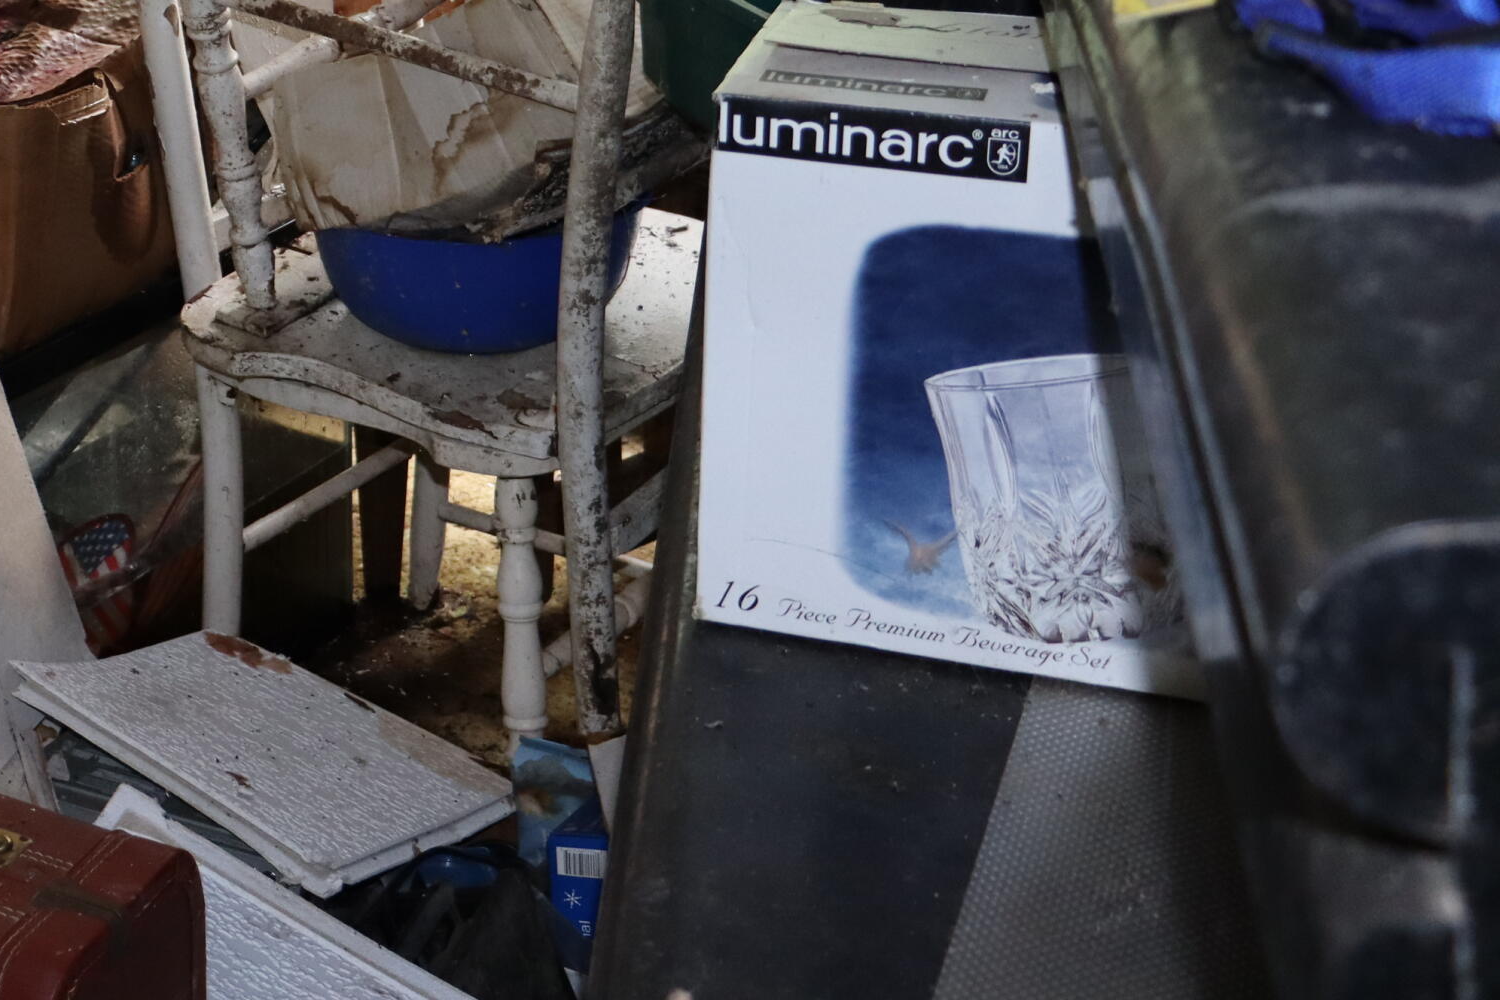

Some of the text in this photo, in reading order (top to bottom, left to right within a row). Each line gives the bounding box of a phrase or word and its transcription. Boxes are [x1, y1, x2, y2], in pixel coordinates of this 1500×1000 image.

[762, 70, 948, 98] luminarc
[990, 128, 1020, 139] arc
[714, 581, 1112, 670] 16 Piece Premium Beverage Set
